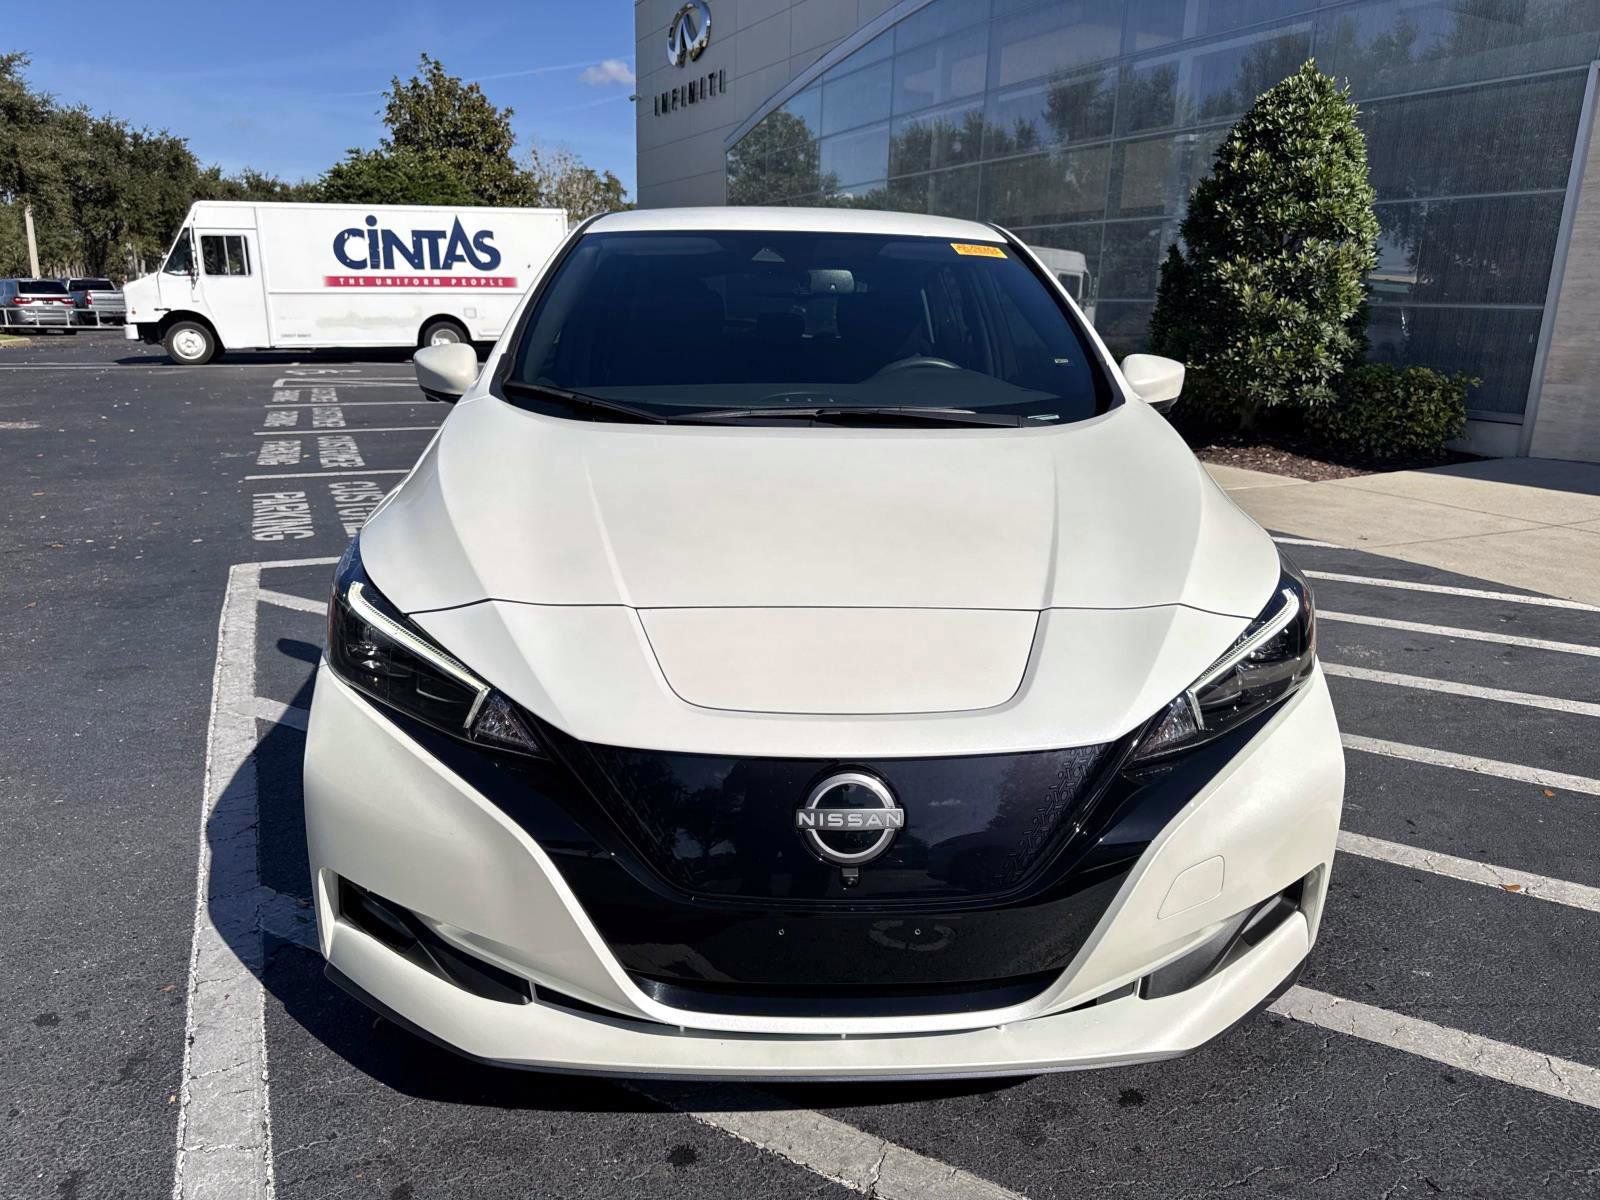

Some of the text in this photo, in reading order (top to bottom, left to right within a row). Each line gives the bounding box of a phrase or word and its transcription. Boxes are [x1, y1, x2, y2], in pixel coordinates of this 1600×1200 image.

[654, 69, 726, 116] INFINITI
[339, 277, 505, 287] THE UNIFORM PEOPLE
[252, 491, 316, 541] PARKING
[798, 812, 902, 827] NISSAN
